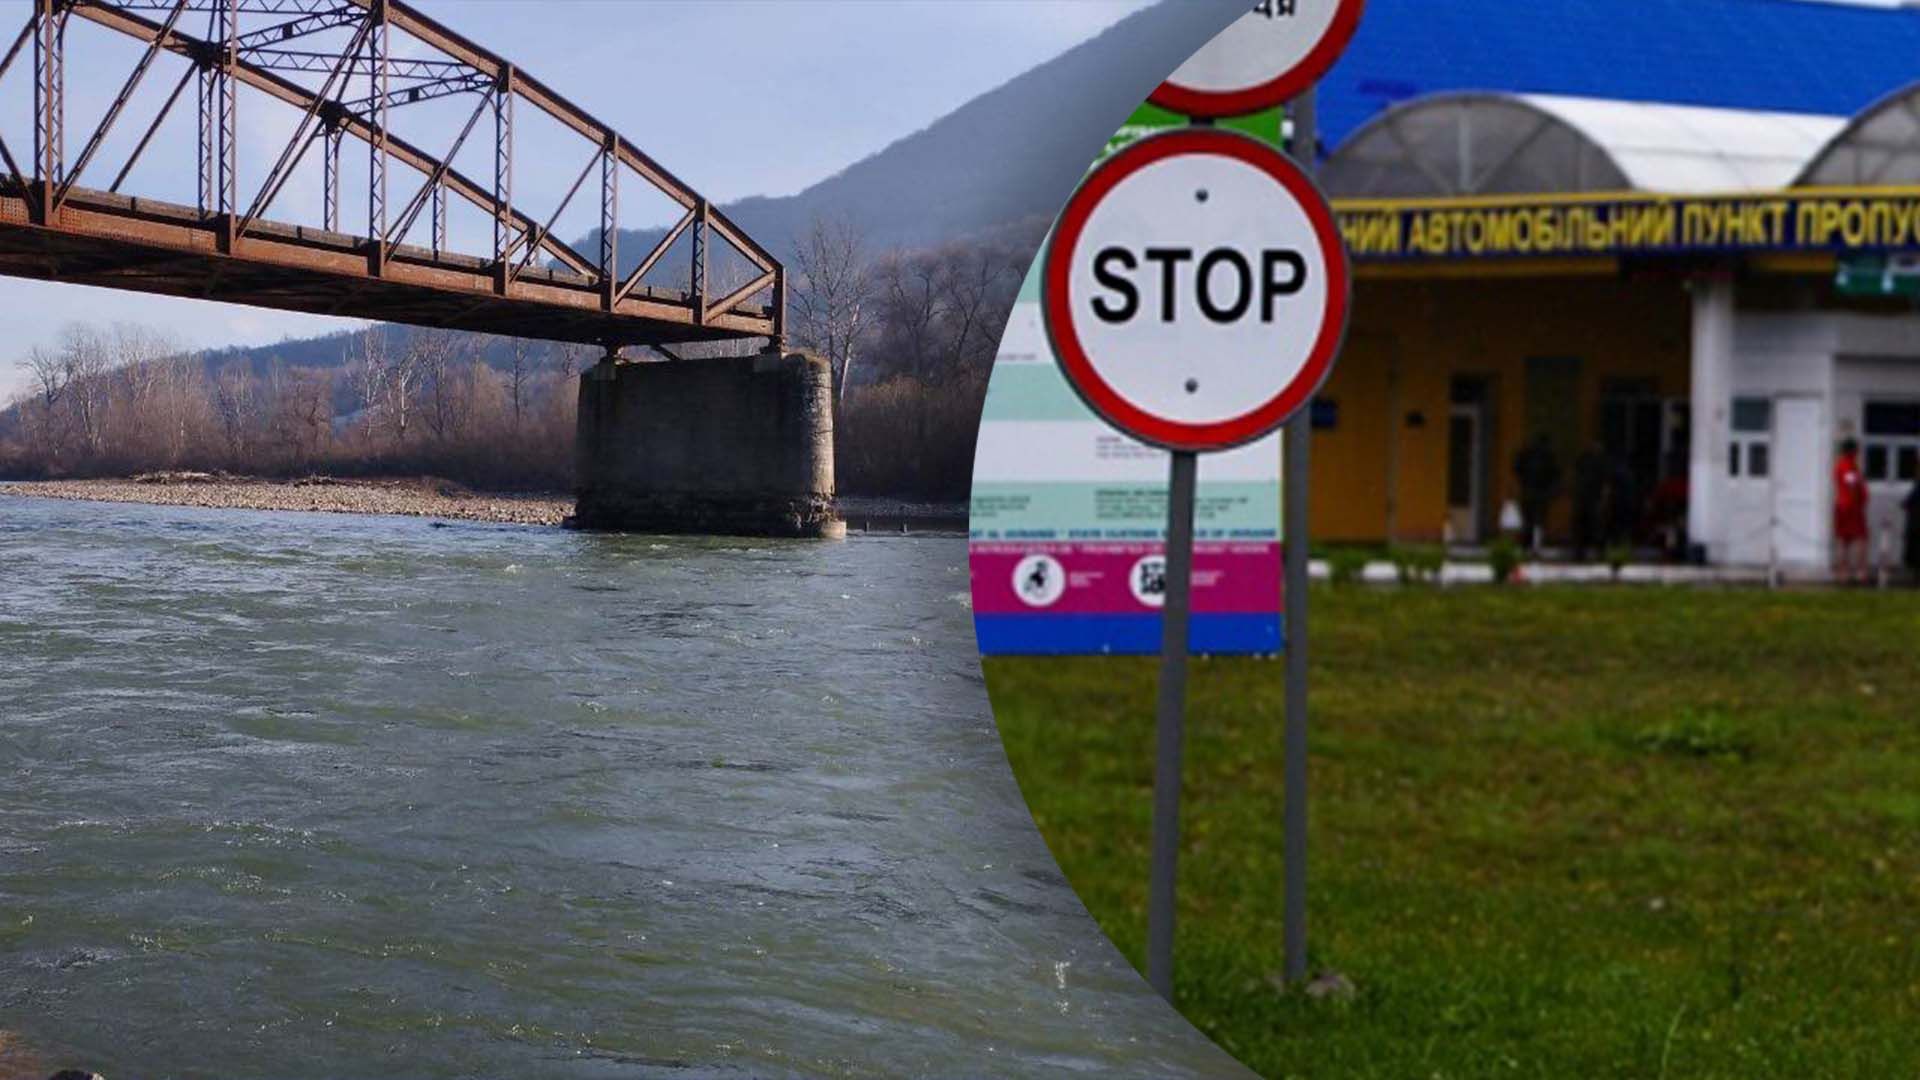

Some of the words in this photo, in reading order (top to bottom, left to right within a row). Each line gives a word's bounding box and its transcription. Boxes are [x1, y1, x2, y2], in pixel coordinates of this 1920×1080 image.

[1408, 197, 1676, 252] АВТОМОБІЛЬНИЙ
[1682, 201, 1789, 246] ПУНКТ
[1091, 246, 1307, 324] STOP
